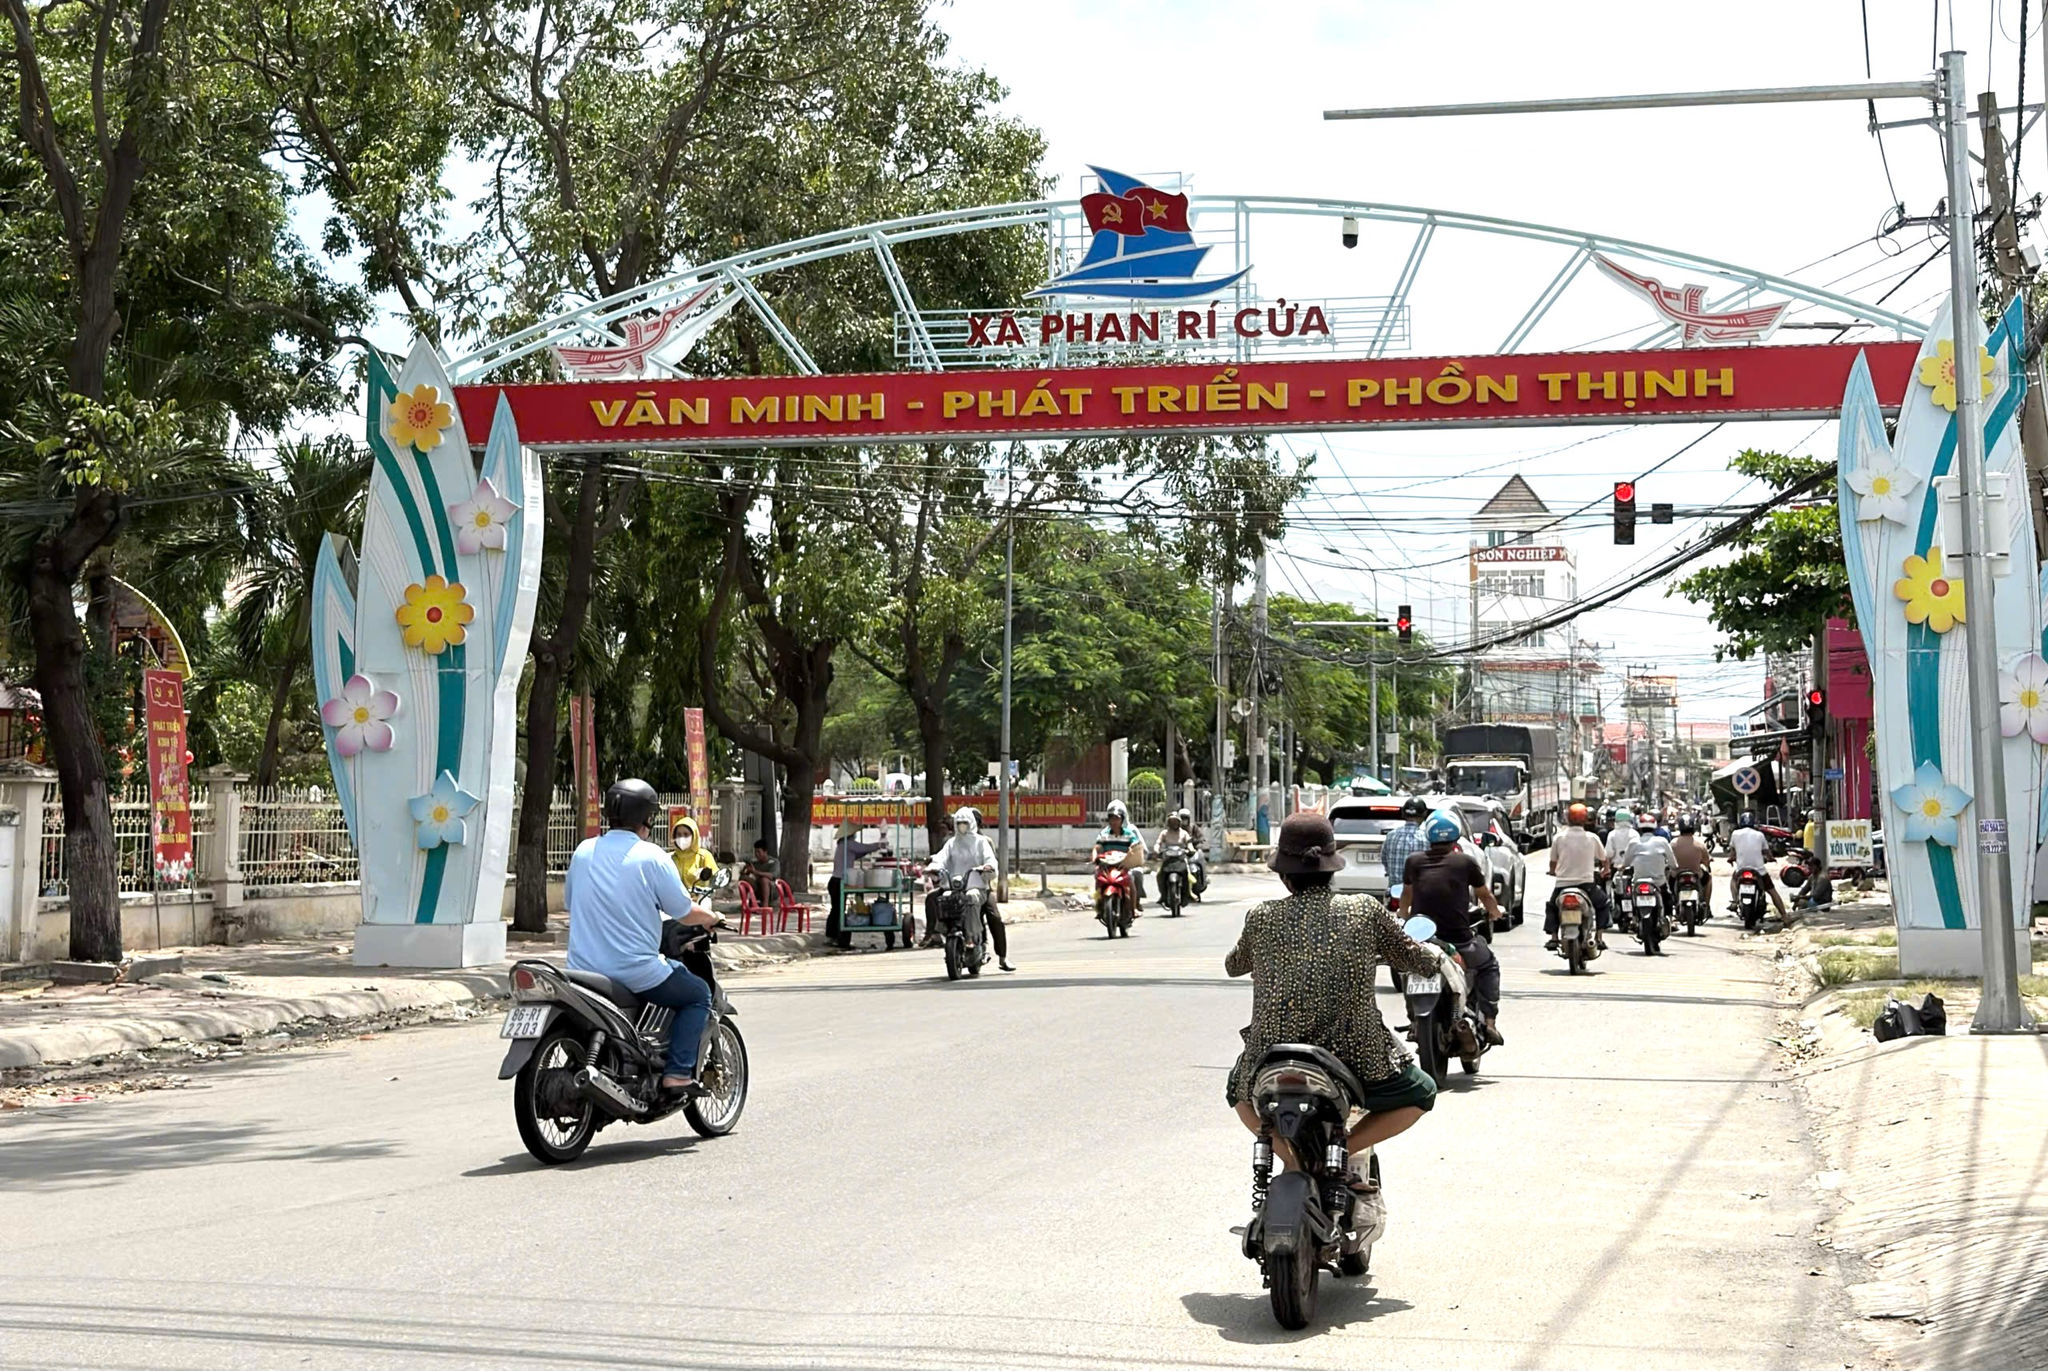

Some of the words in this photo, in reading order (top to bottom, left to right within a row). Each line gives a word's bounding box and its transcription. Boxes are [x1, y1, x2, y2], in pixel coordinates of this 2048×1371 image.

[966, 309, 1026, 347] XÃ
[1041, 310, 1161, 344] PHAN
[1177, 299, 1220, 340] RÍ
[1233, 298, 1330, 338] CỬA
[590, 391, 709, 427] VĂN
[730, 393, 885, 424] MINH
[942, 378, 1093, 418] PHÁT
[1111, 367, 1288, 414] TRIỂN
[1347, 362, 1519, 407] PHỒN
[1538, 368, 1734, 408] THỊNH
[505, 1022, 538, 1036] 2203
